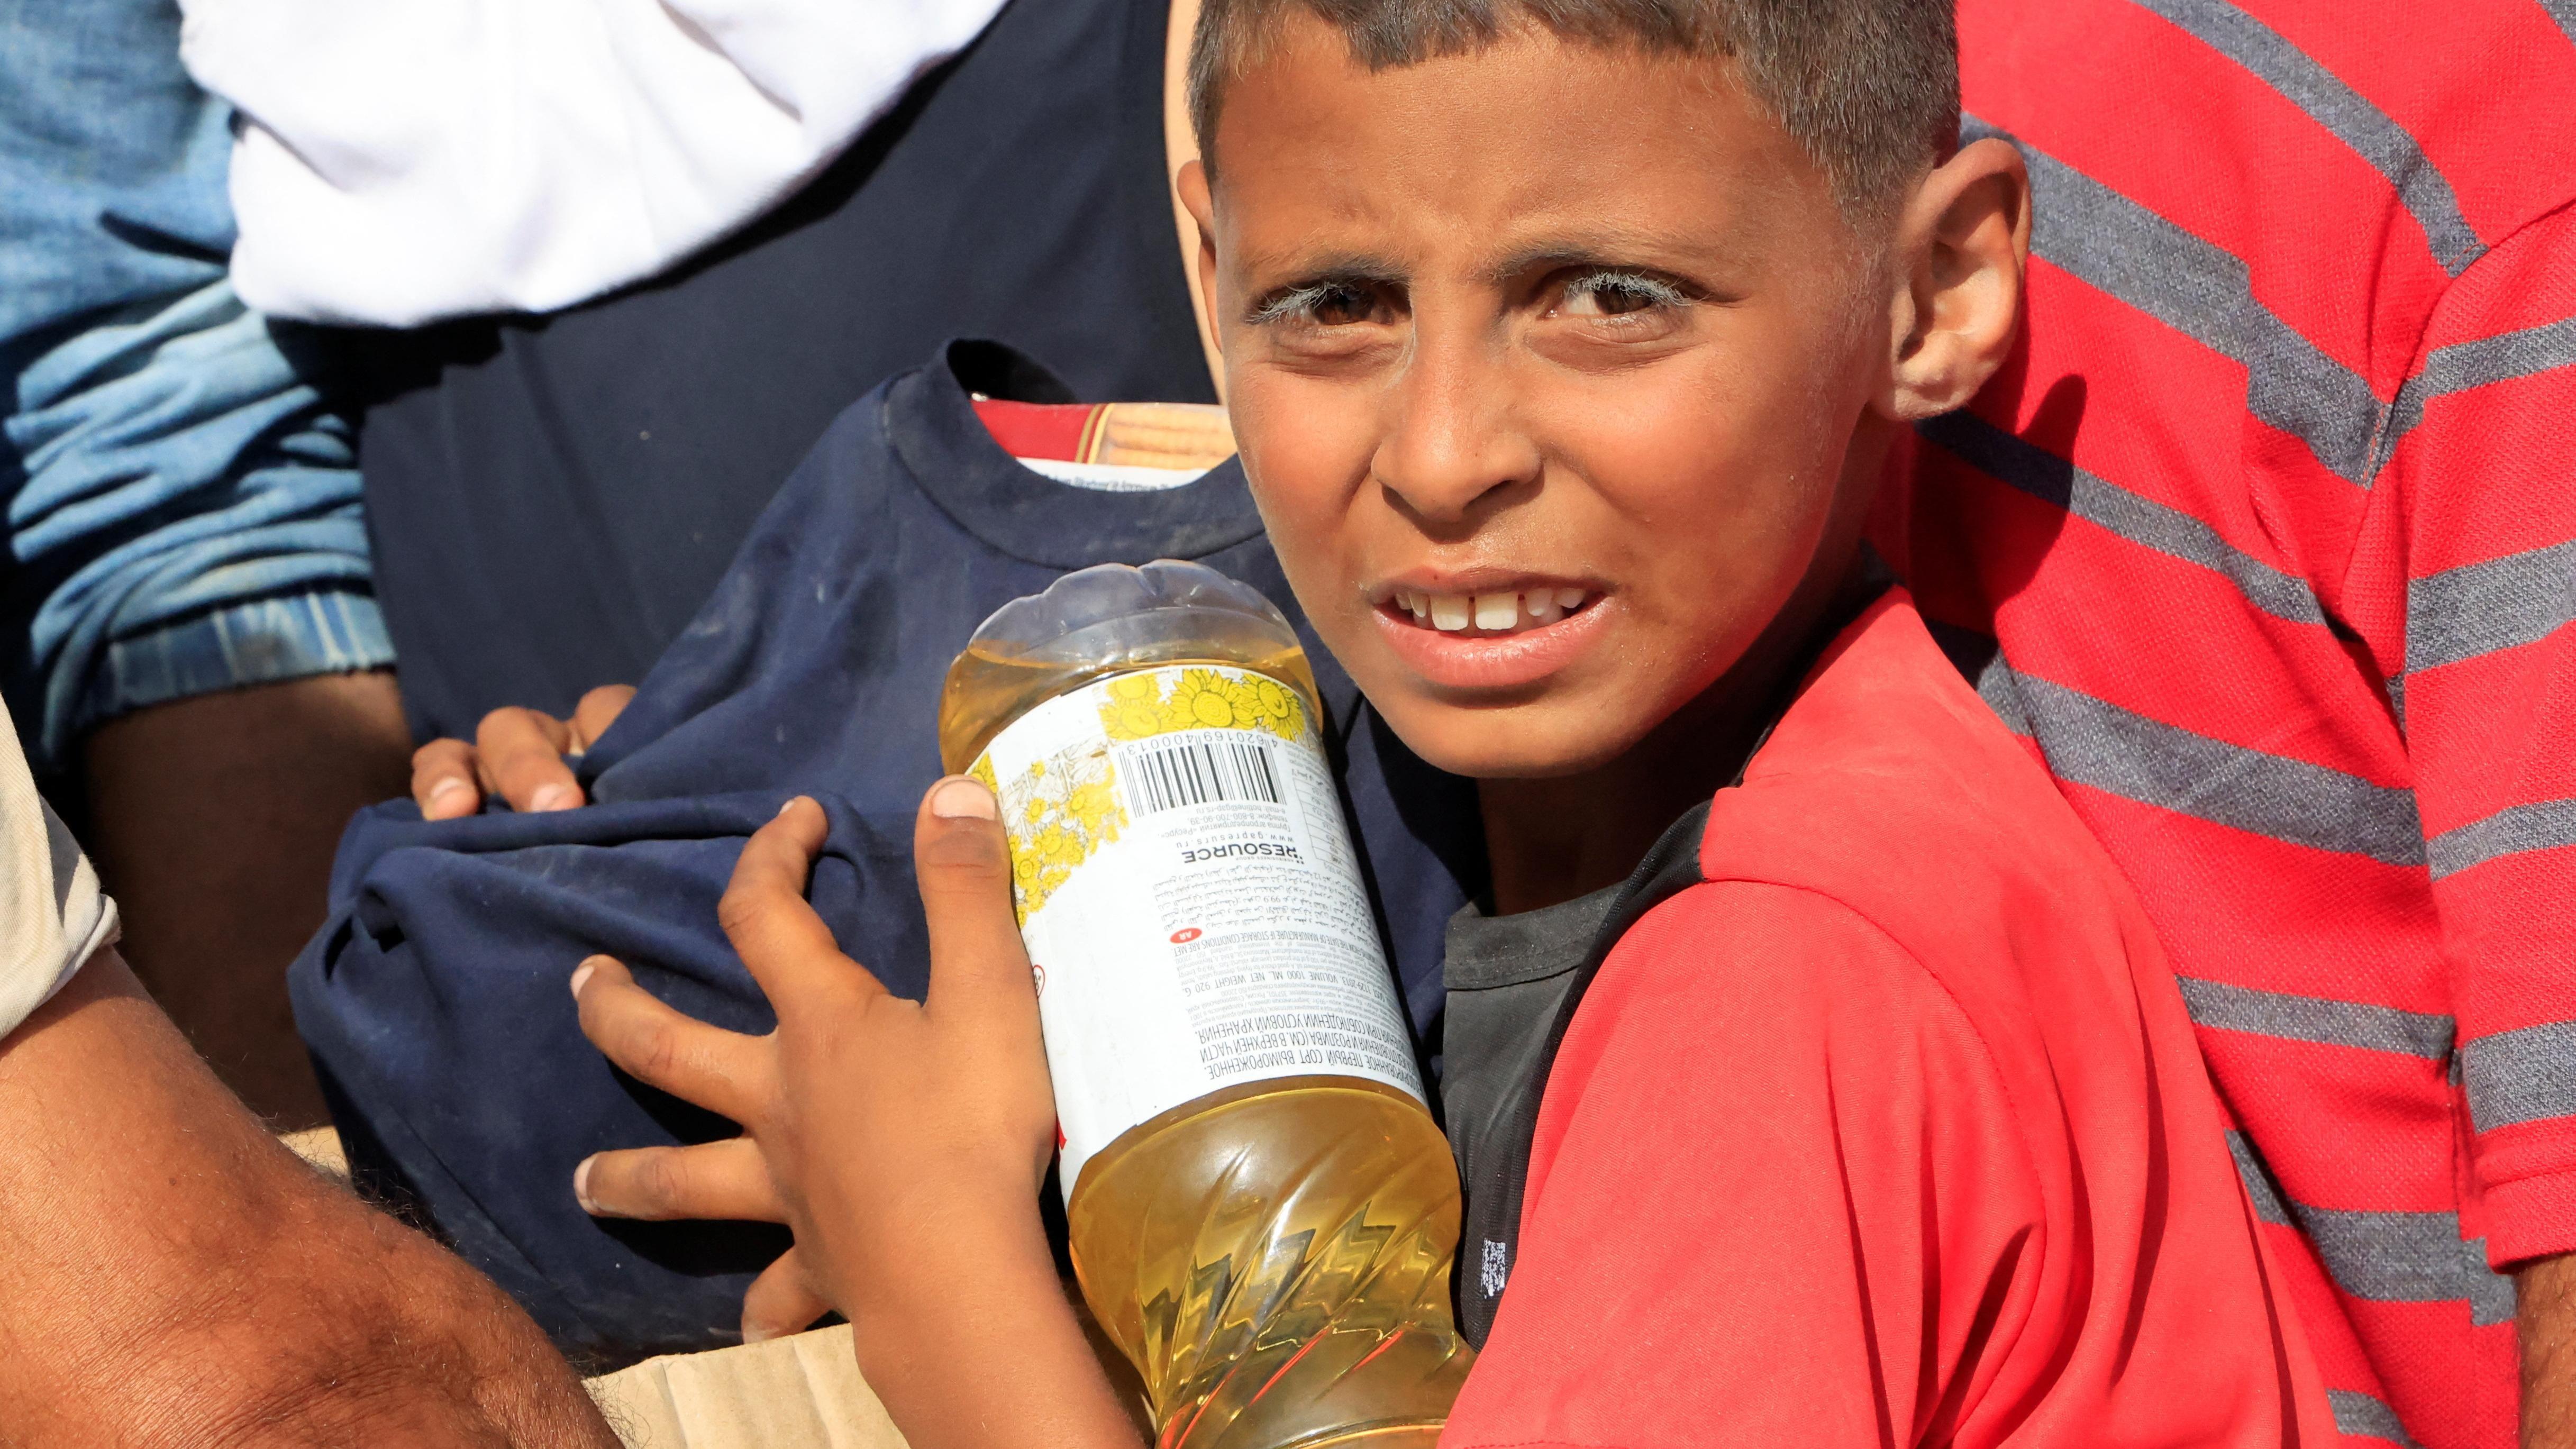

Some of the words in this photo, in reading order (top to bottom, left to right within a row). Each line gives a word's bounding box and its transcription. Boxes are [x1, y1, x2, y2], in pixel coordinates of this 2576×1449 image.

[1126, 733, 1194, 755] 400013
[1203, 731, 1264, 745] 620169
[1271, 739, 1278, 748] 4
[1267, 822, 1290, 832] Группа
[1176, 831, 1294, 847] www.gapresurs.ru
[1181, 843, 1298, 863] RESOURCE
[1177, 929, 1193, 942] AR
[1201, 933, 1240, 949] CONDITIONS
[1240, 931, 1269, 942] STORAGE
[1275, 930, 1319, 942] MANUFACTURE
[1171, 944, 1187, 957] MET.
[1187, 941, 1200, 952] ARE
[1215, 974, 1246, 988] WEIGHT
[1250, 972, 1265, 982] NET
[1268, 971, 1283, 980] ML.
[1287, 970, 1305, 979] 1000
[1308, 971, 1338, 983] VOLUME
[1182, 987, 1191, 997] G.
[1195, 981, 1210, 993] 920
[1254, 1013, 1305, 1033] УСЛОВИЙ
[1303, 1012, 1366, 1034] СОБЛЮДЕНИИ
[1195, 1018, 1254, 1044] ХРАНЕНИЯ.
[1286, 1029, 1308, 1046] (СМ.
[1364, 1022, 1382, 1041] ПРИ
[1233, 1033, 1279, 1055] ВЕРХНЕЙ
[1278, 1032, 1287, 1046] В
[1309, 1031, 1351, 1048] РОЗЛИВА
[1351, 1036, 1358, 1049] И
[1199, 1041, 1233, 1063] ЧАСТИ
[1299, 1049, 1323, 1063] СОРТ
[1325, 1050, 1363, 1068] ПЕРВЫЙ
[1204, 1050, 1295, 1080] ВЫМОРОЖЕННОЕ.
